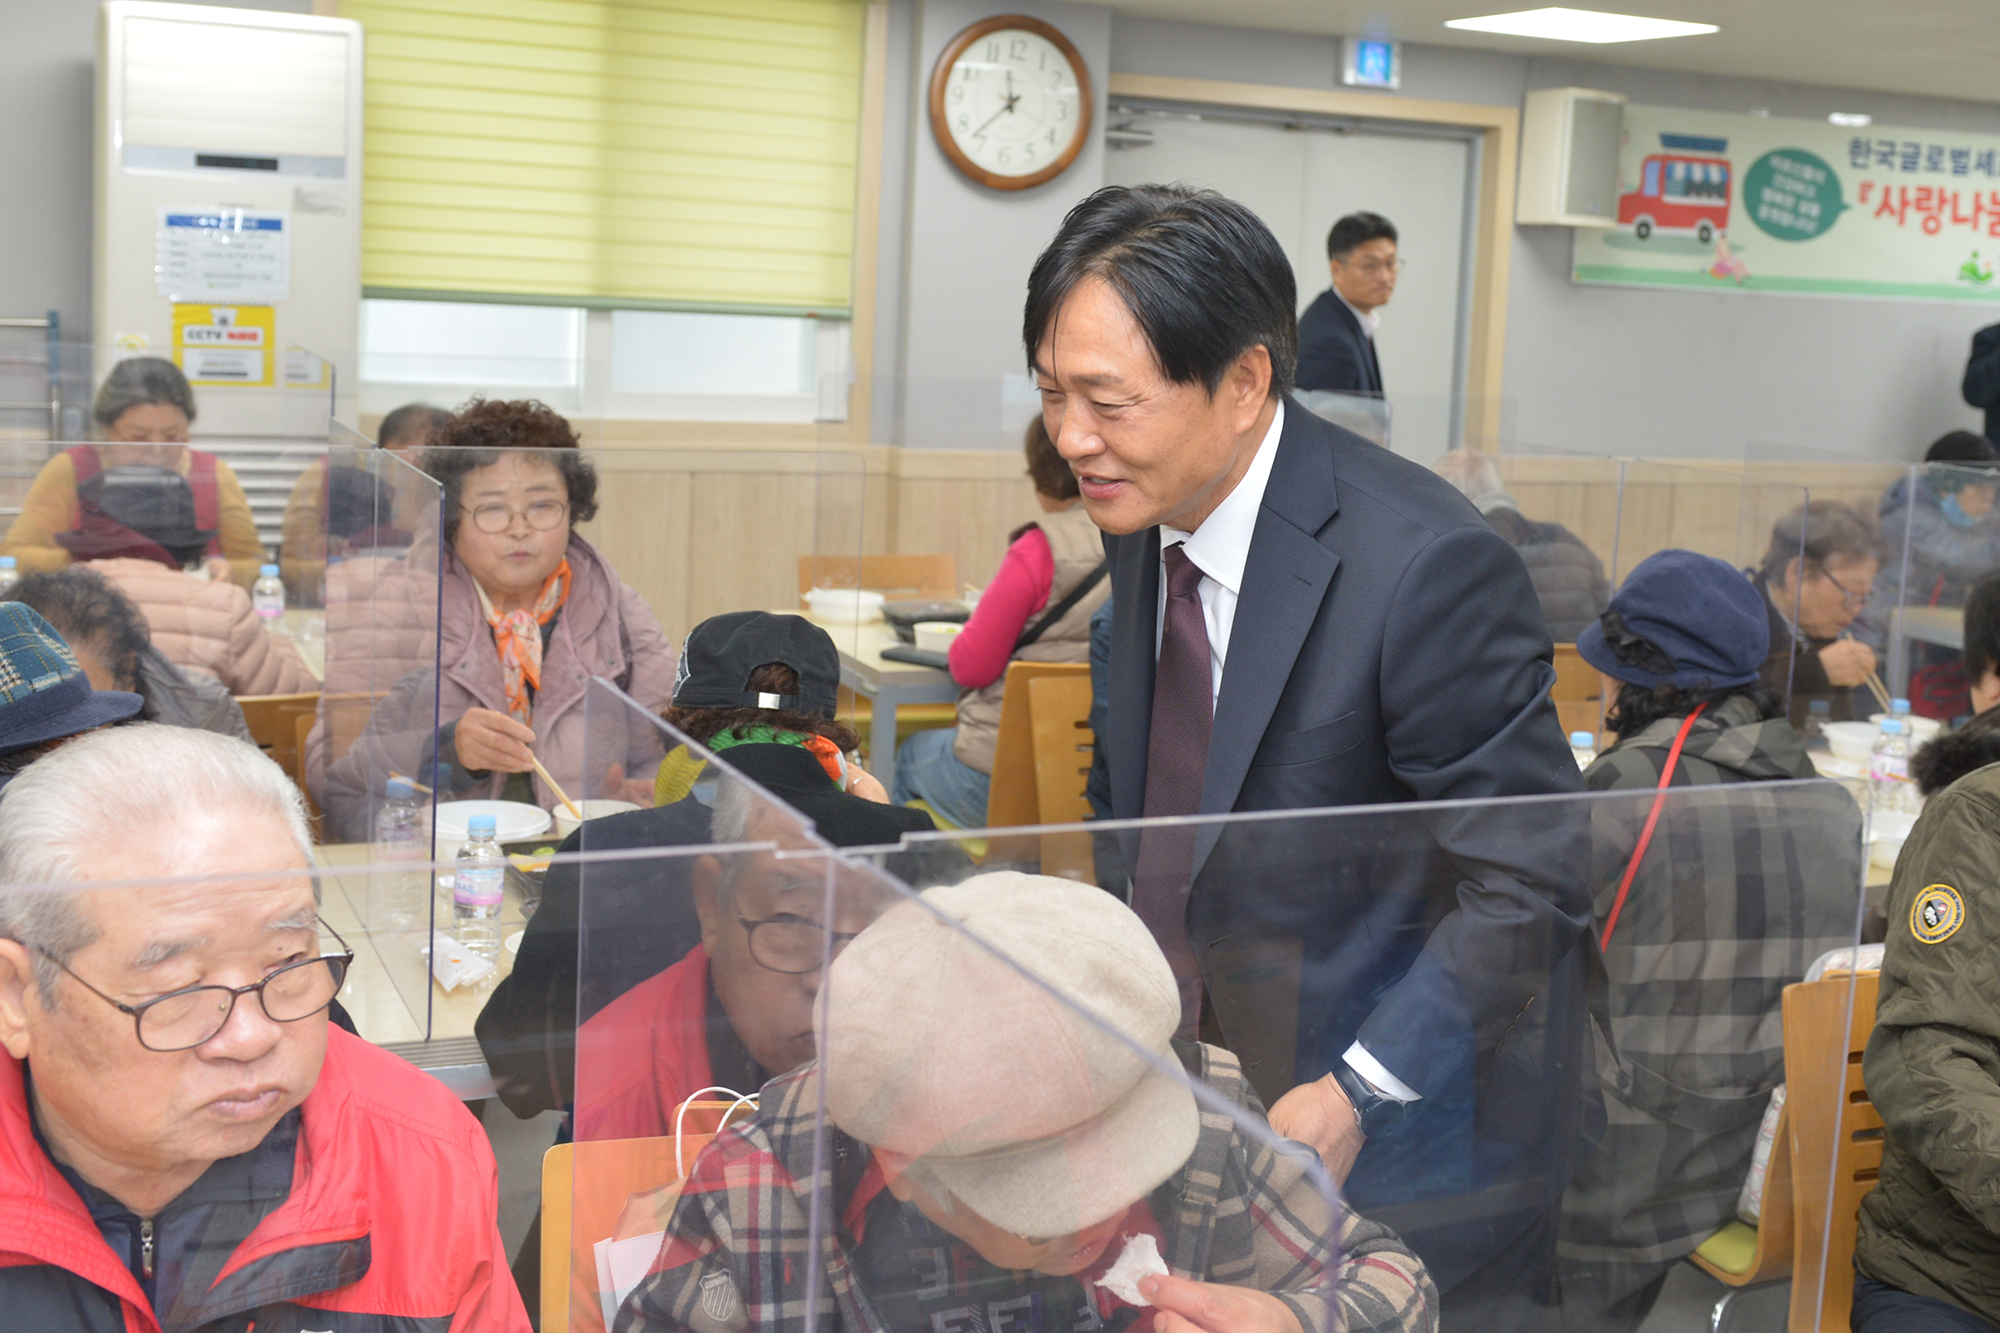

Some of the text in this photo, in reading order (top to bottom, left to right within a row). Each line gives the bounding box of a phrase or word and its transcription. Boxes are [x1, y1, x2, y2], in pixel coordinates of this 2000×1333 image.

[1009, 38, 1028, 62] 12
[1848, 136, 2000, 177] 한국글로벌세
[187, 328, 222, 341] CCTV
